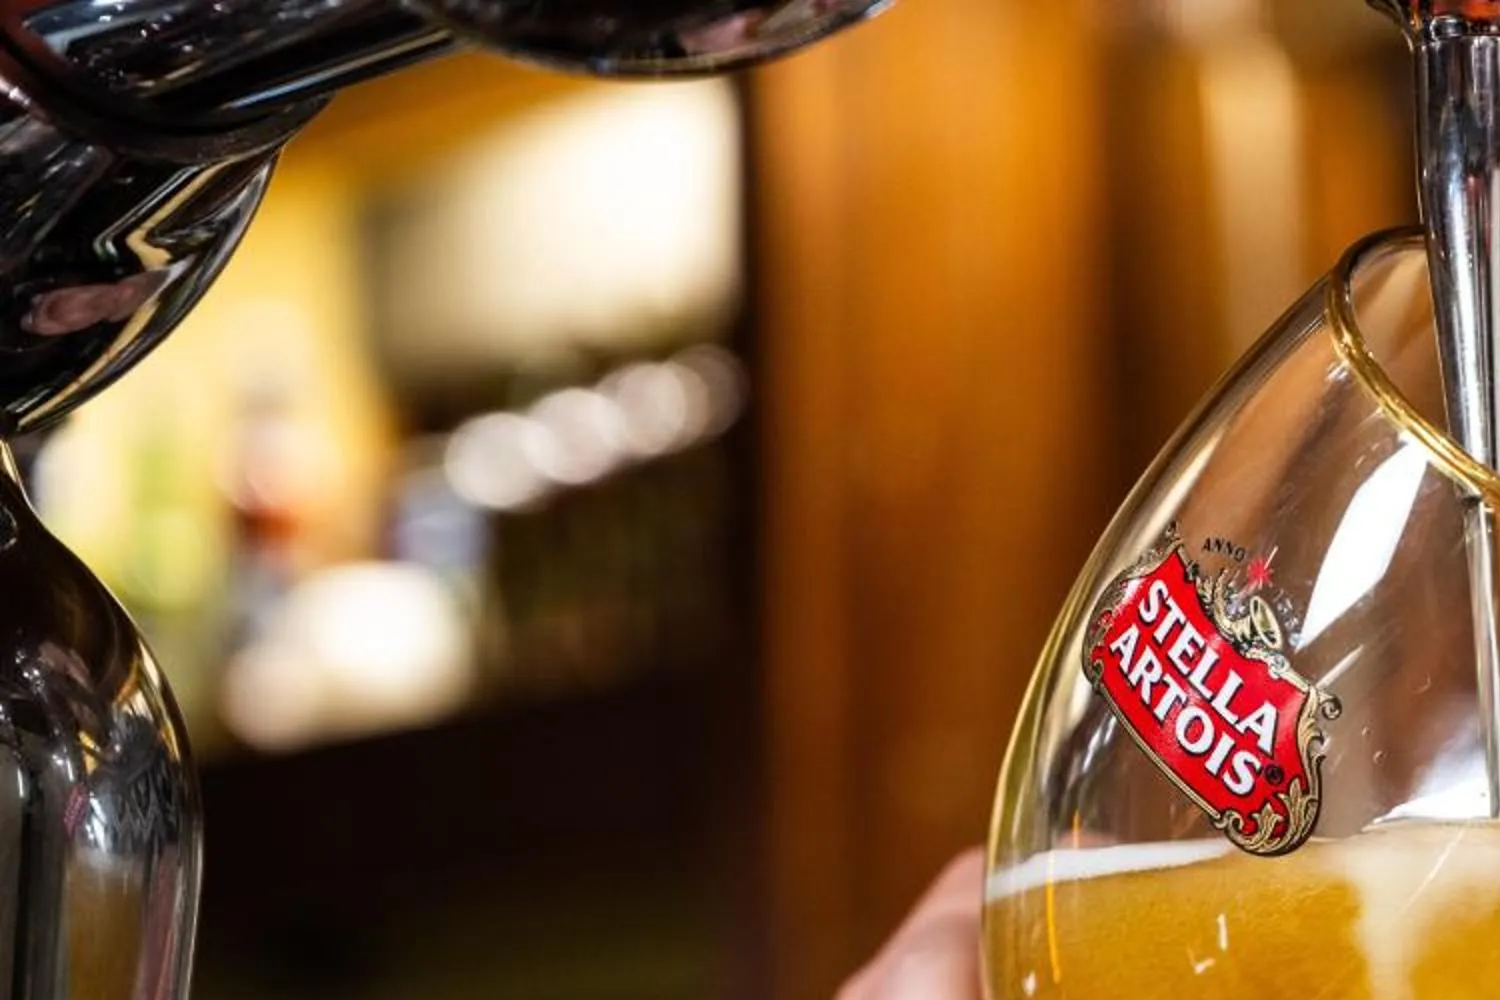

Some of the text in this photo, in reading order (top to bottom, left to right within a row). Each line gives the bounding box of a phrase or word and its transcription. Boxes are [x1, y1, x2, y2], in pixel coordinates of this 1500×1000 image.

[1203, 538, 1246, 562] ANNO
[1110, 624, 1262, 796] ARTOIS
[1139, 579, 1279, 756] STELLA
